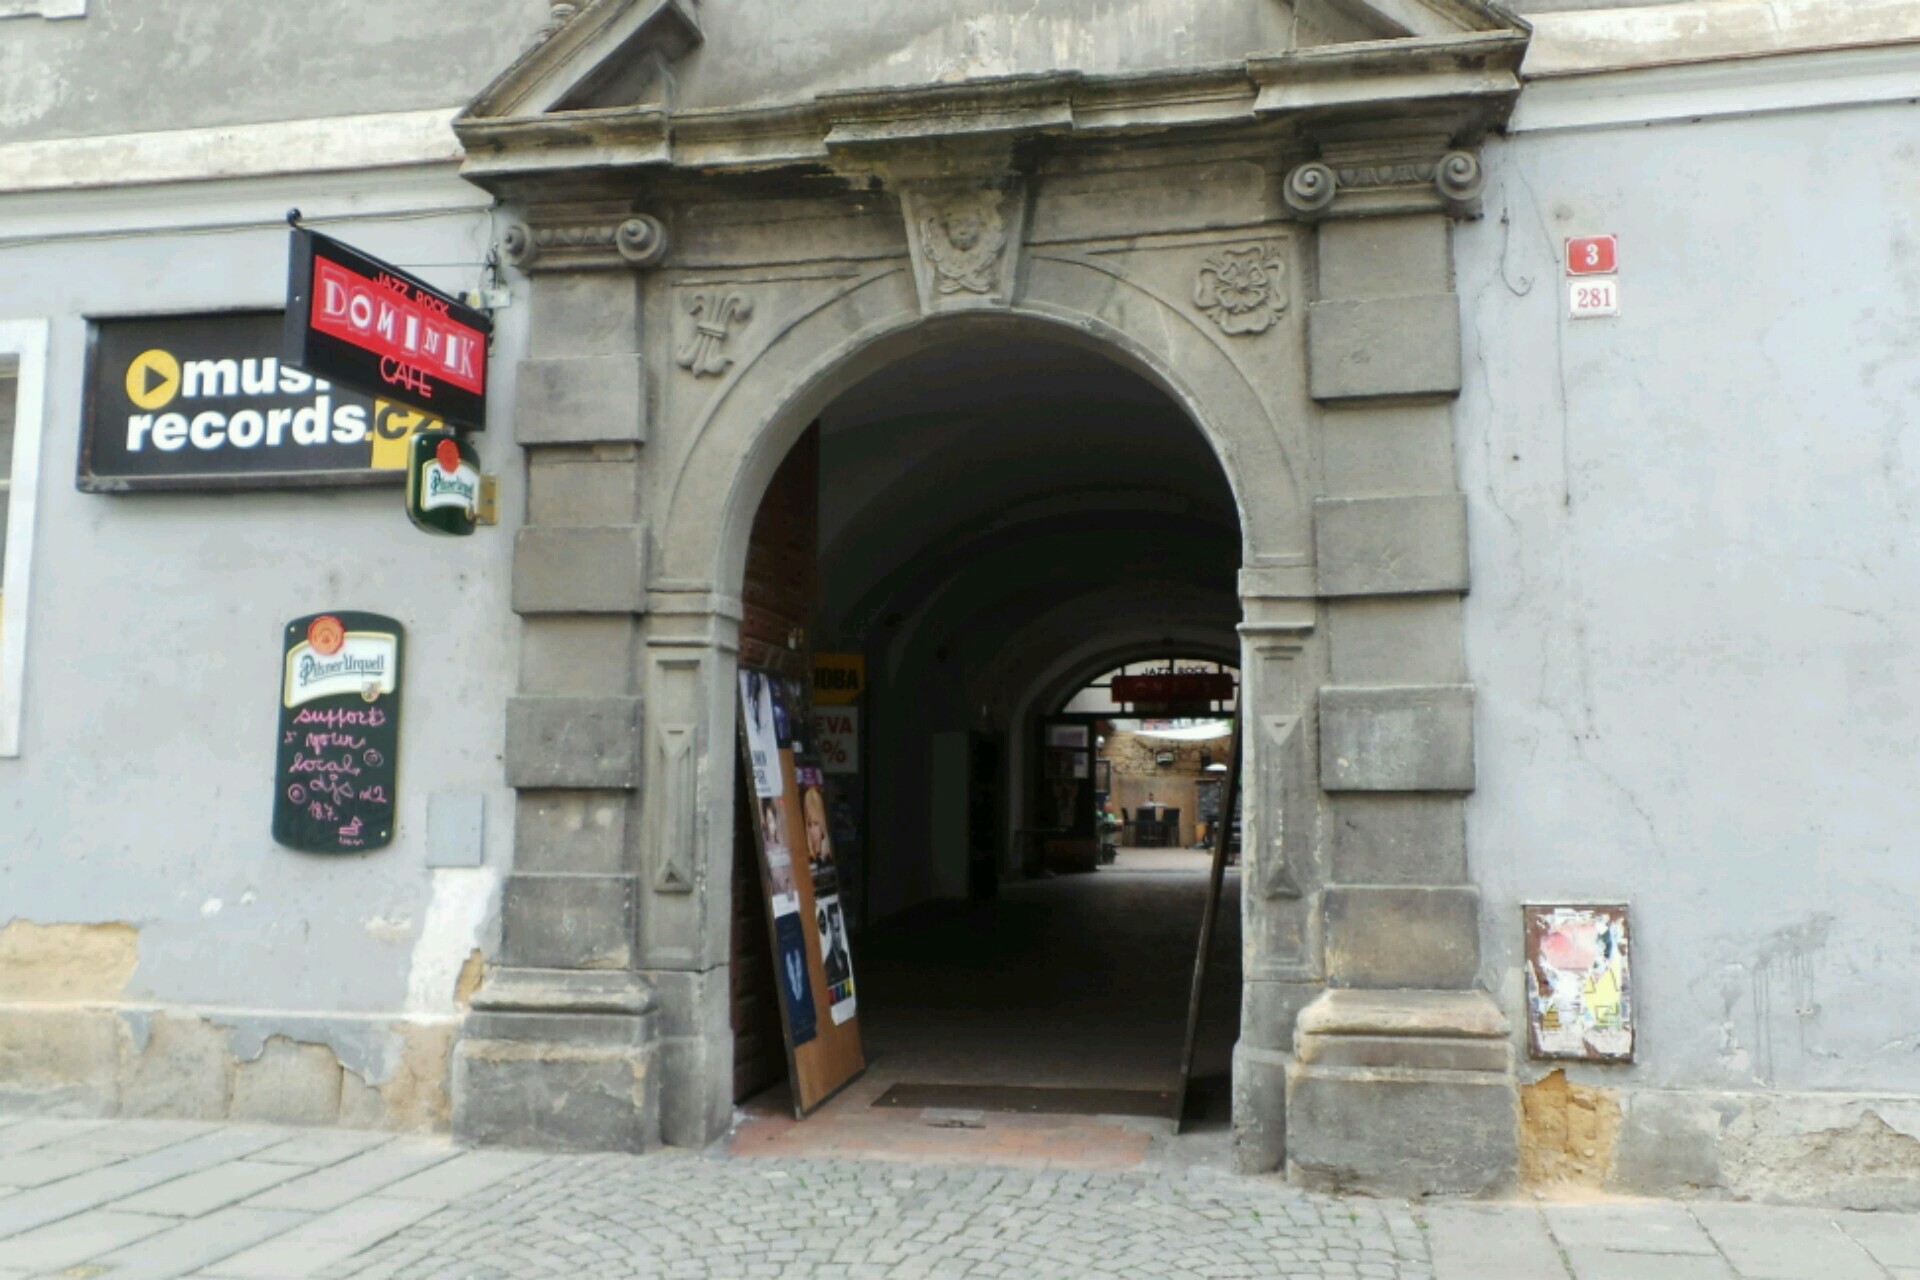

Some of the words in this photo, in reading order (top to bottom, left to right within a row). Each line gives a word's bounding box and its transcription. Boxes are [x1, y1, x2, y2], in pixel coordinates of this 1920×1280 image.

[1585, 243, 1599, 266] 3
[373, 271, 409, 296] JAZZ
[415, 291, 449, 315] ROCK
[1577, 287, 1611, 309] 281
[322, 278, 475, 379] DOMINIK
[380, 355, 432, 398] CAFE
[300, 654, 343, 687] Pilsner
[343, 653, 385, 677] Urquell
[293, 707, 386, 729] support
